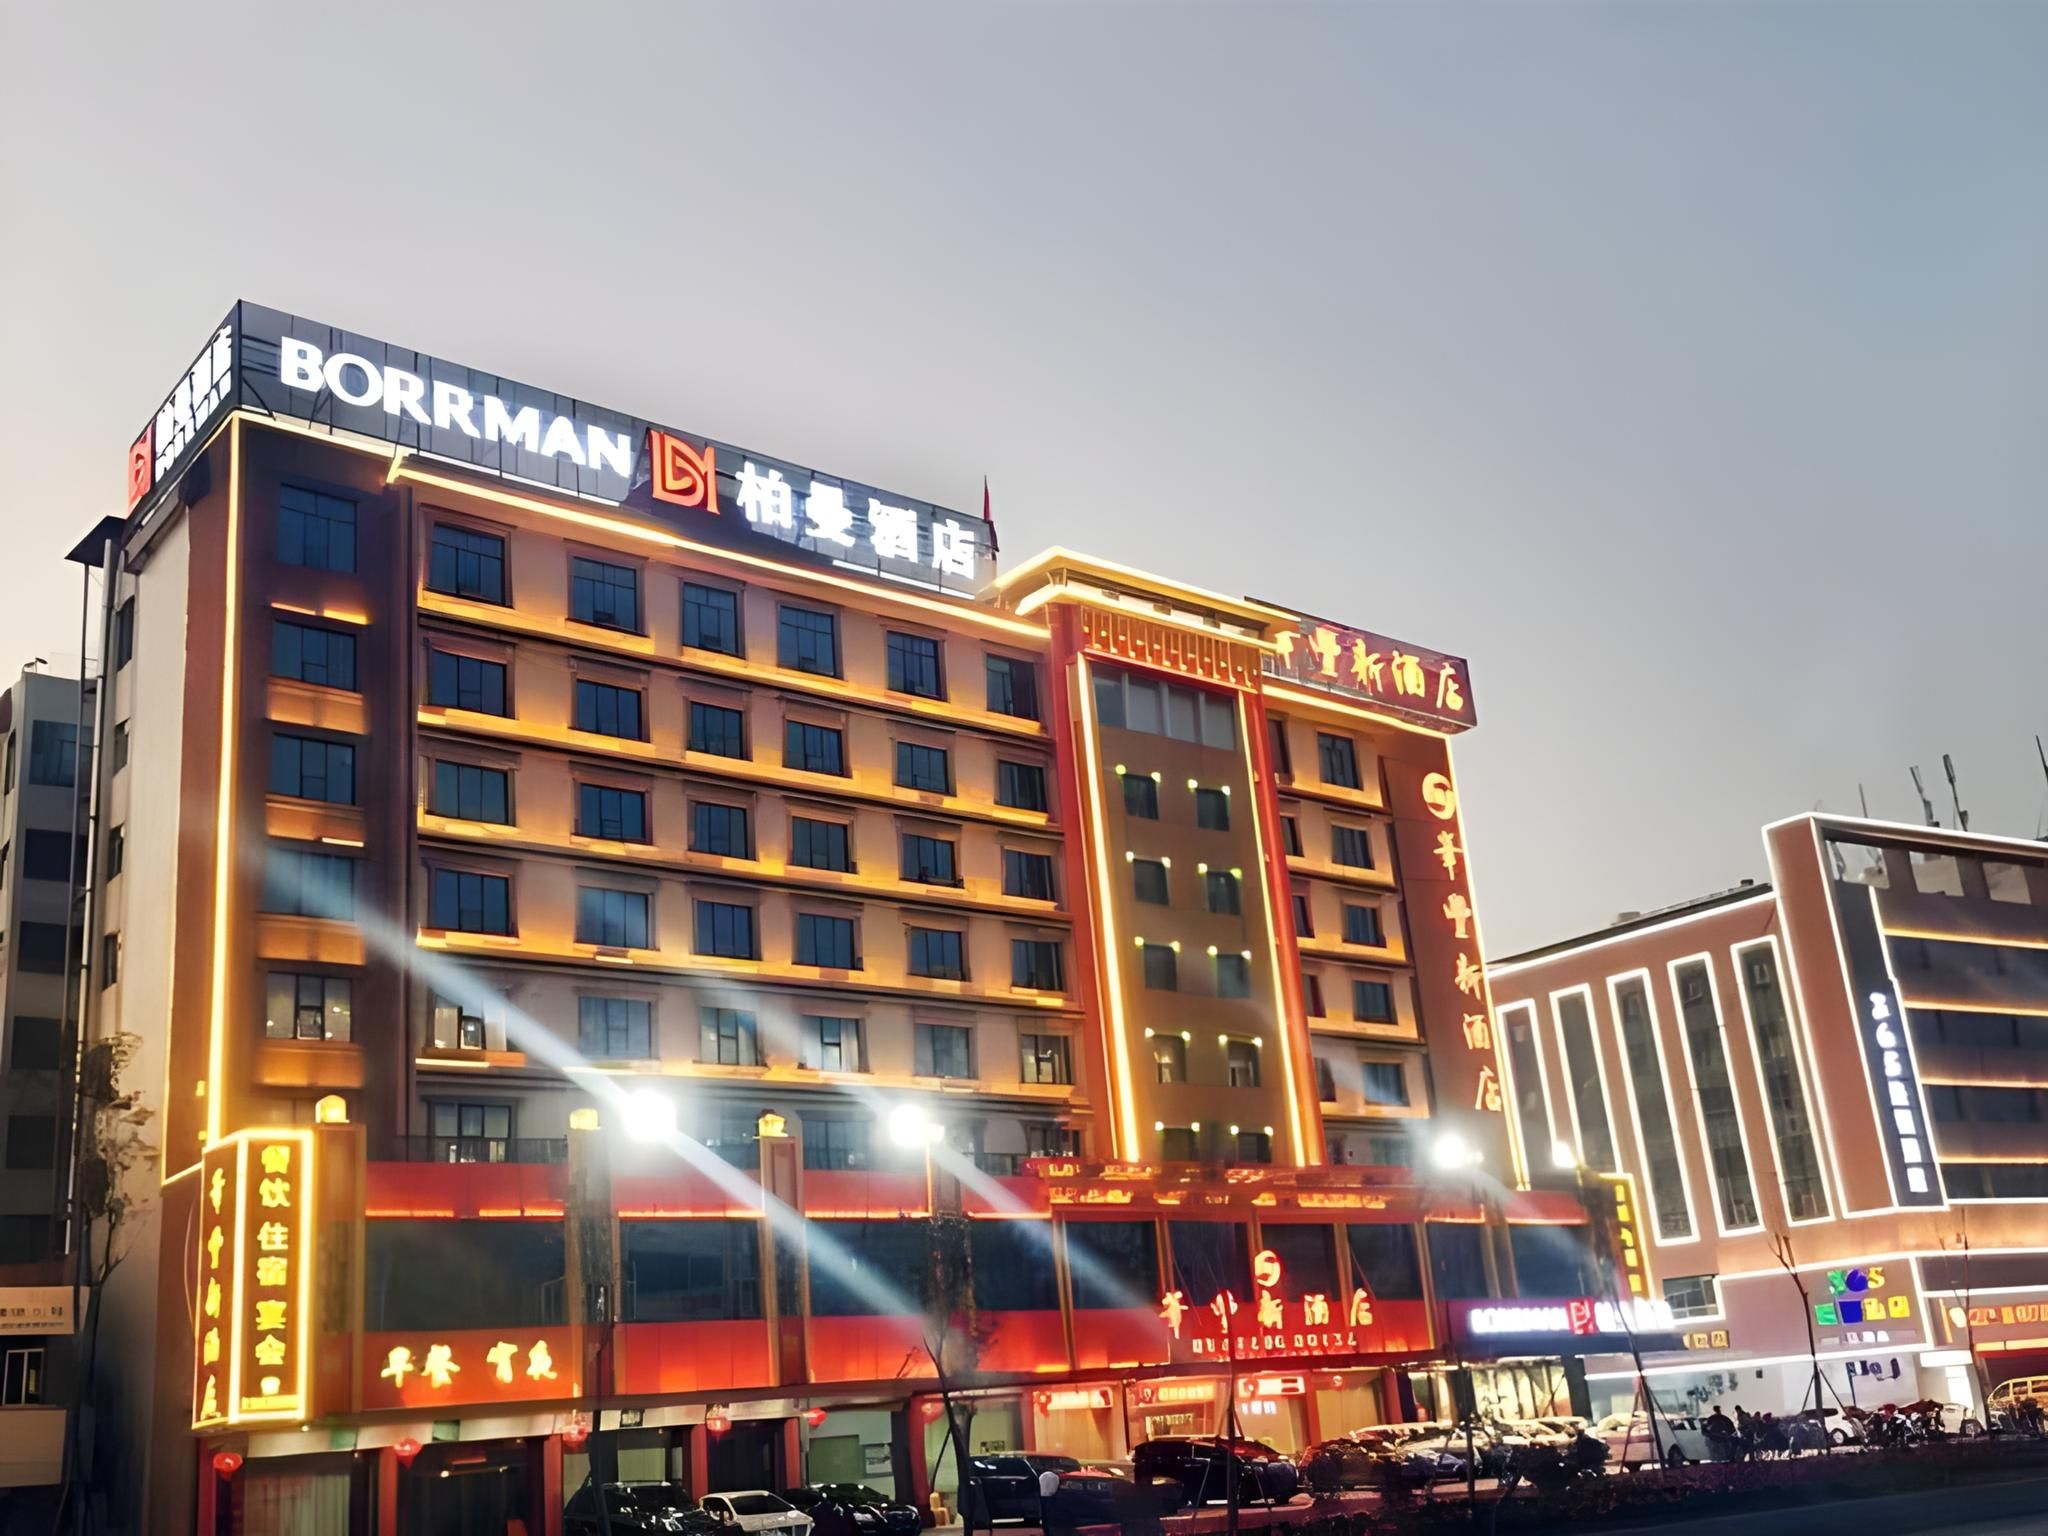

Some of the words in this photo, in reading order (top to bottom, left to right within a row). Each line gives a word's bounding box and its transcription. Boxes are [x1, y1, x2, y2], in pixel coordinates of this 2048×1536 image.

[280, 335, 631, 477] BORRMAN
[735, 460, 975, 580] 柏曼酒店
